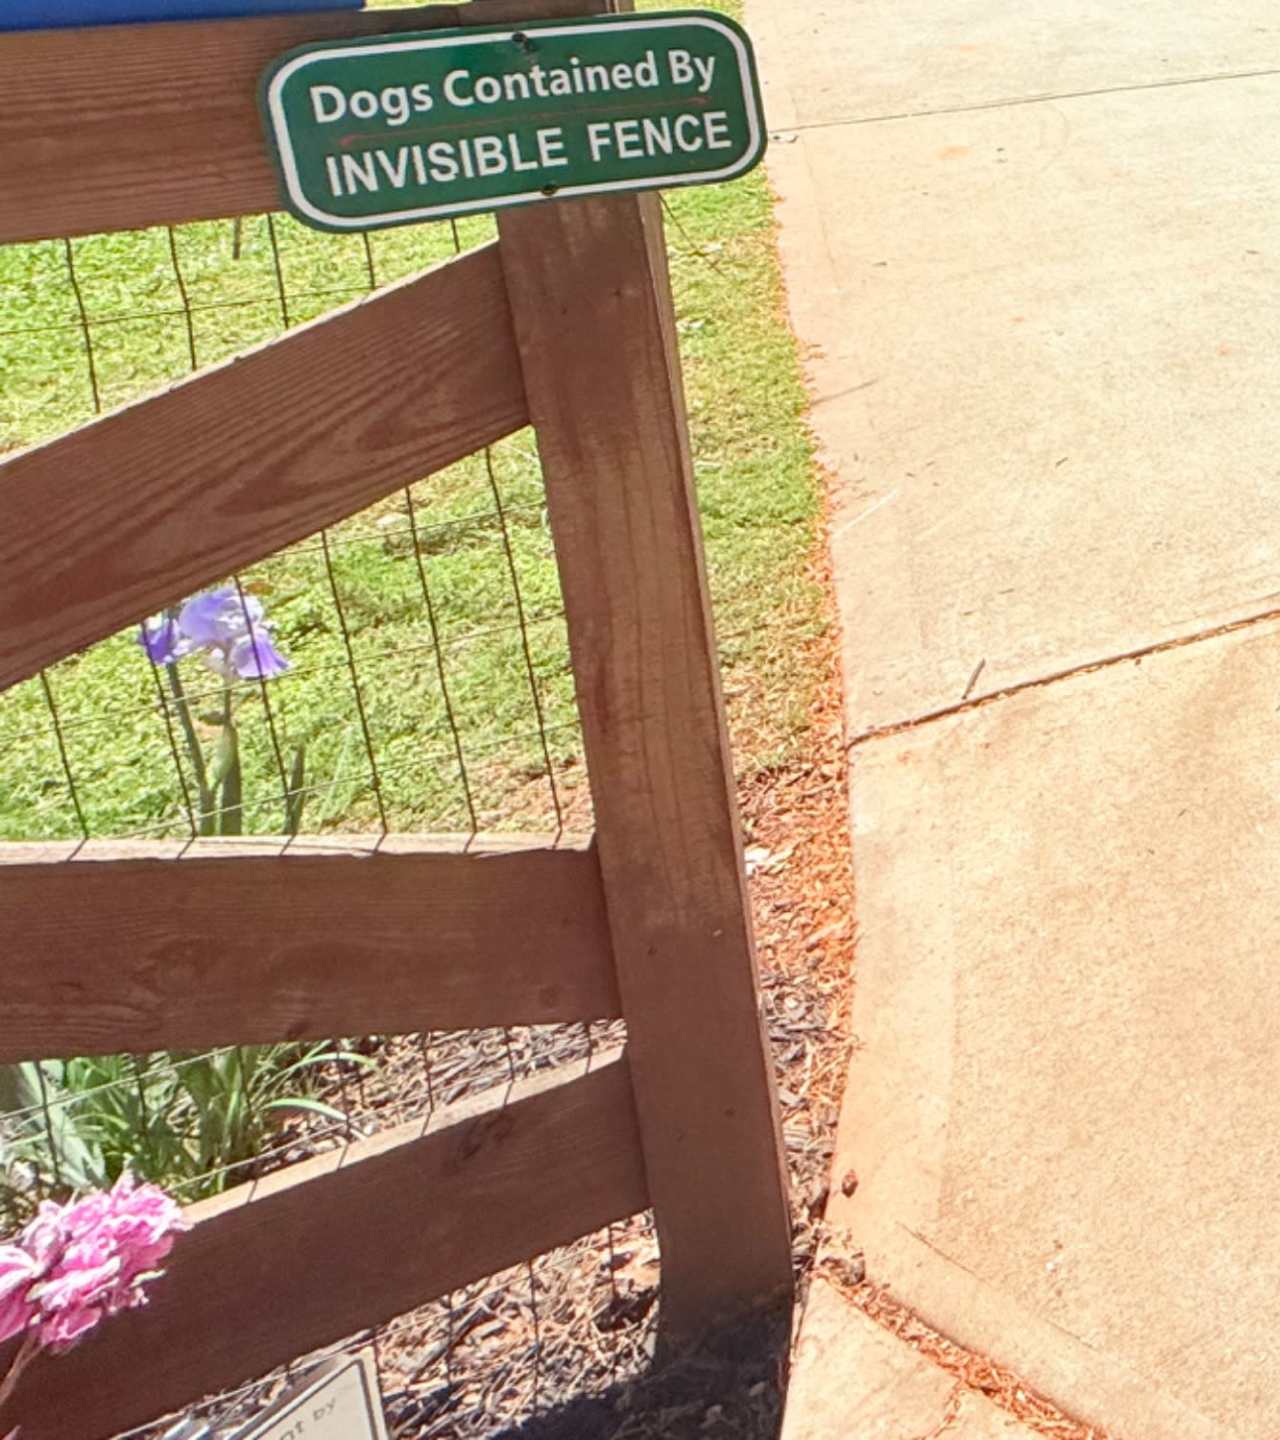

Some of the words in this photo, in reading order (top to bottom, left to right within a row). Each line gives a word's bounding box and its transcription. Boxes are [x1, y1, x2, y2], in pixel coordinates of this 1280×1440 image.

[309, 83, 433, 126] Dogs
[444, 50, 660, 107] Contained
[668, 49, 715, 93] By
[325, 127, 568, 197] INVISIBLE
[587, 111, 732, 162] FENCE
